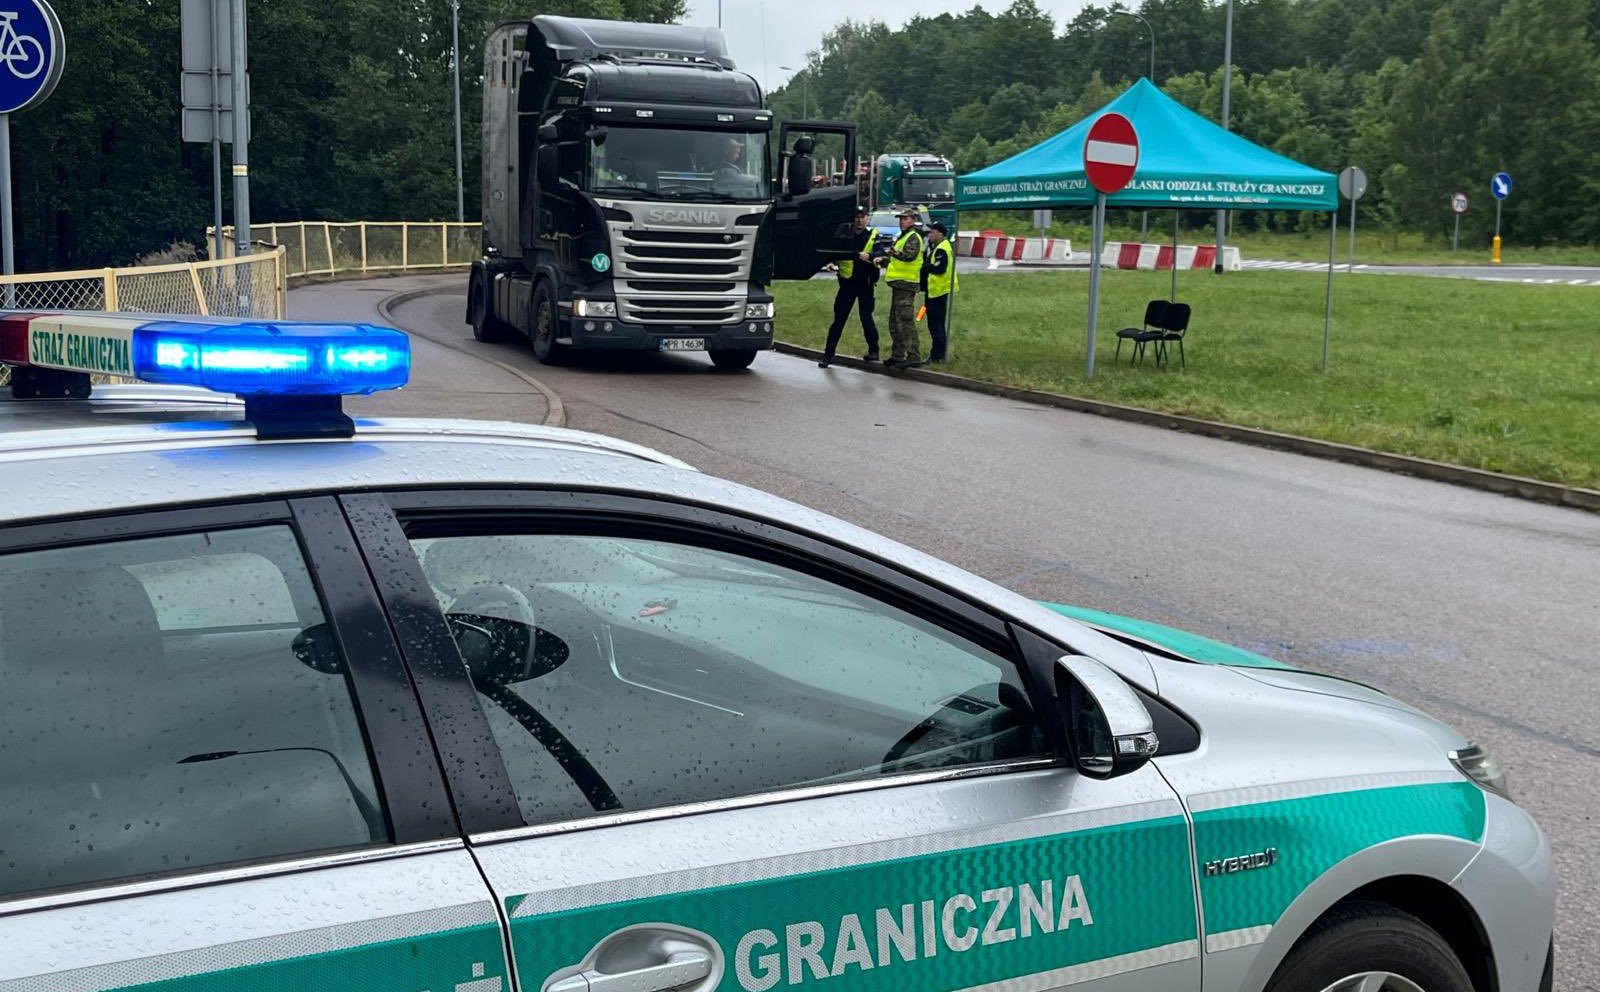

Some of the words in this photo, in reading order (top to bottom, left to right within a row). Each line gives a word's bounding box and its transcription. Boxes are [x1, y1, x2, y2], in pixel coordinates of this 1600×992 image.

[963, 185, 992, 195] PODLASKI
[992, 183, 1019, 194] ODDZIAŁ
[1019, 180, 1043, 192] STRAŻY
[1044, 179, 1087, 191] GRANICZNEJ
[1166, 181, 1214, 192] ODDZIAŁ
[1216, 181, 1257, 193] STRAŻY
[1259, 184, 1325, 195] GRANICZNEJ
[648, 209, 721, 225] SCANIA
[32, 324, 64, 366] STRAŻ
[67, 333, 130, 375] GRANICZNA
[734, 873, 1094, 992] GRANICZNA
